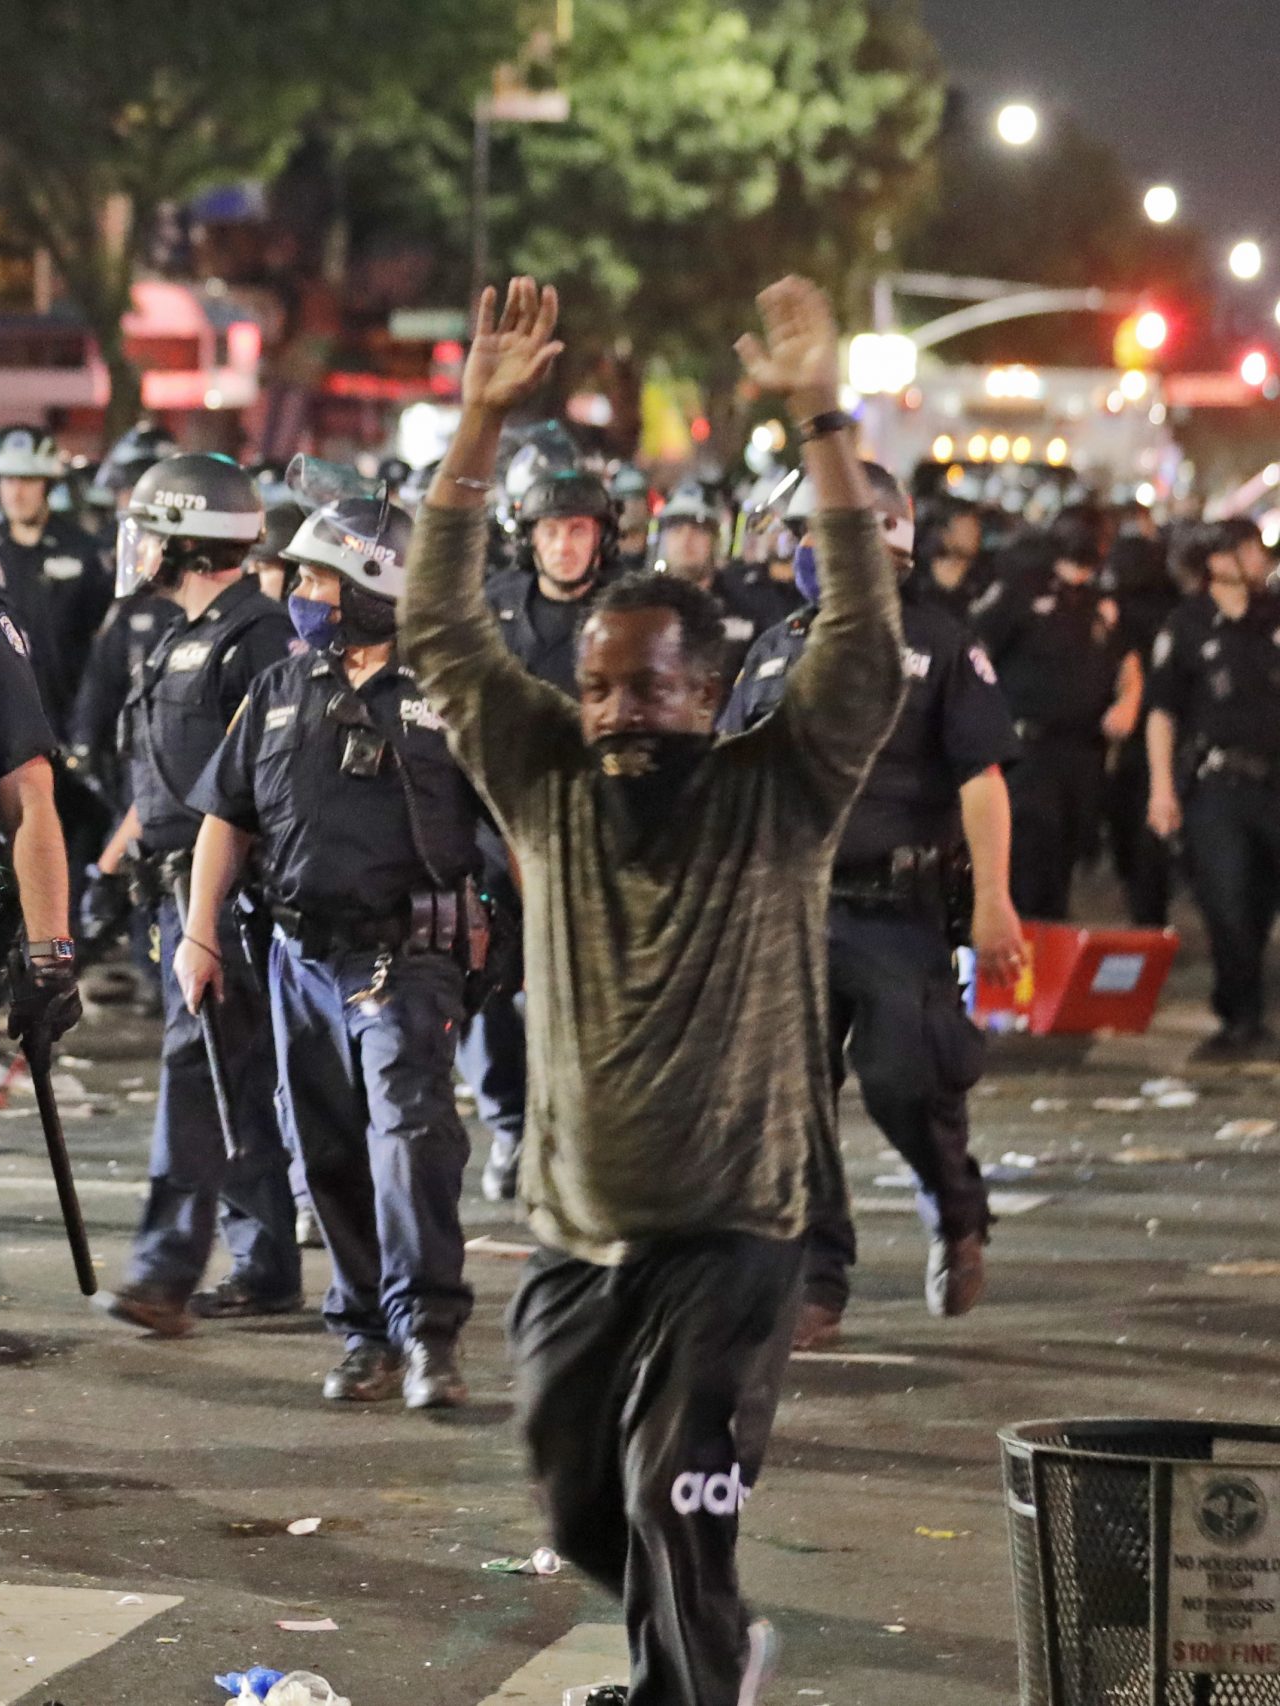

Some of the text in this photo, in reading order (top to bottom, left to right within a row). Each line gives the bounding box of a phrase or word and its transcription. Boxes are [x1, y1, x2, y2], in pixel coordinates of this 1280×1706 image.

[670, 1461, 751, 1516] ad
[1173, 1554, 1195, 1571] NO
[1181, 1595, 1203, 1612] NO
[1231, 1642, 1280, 1665] FINE
